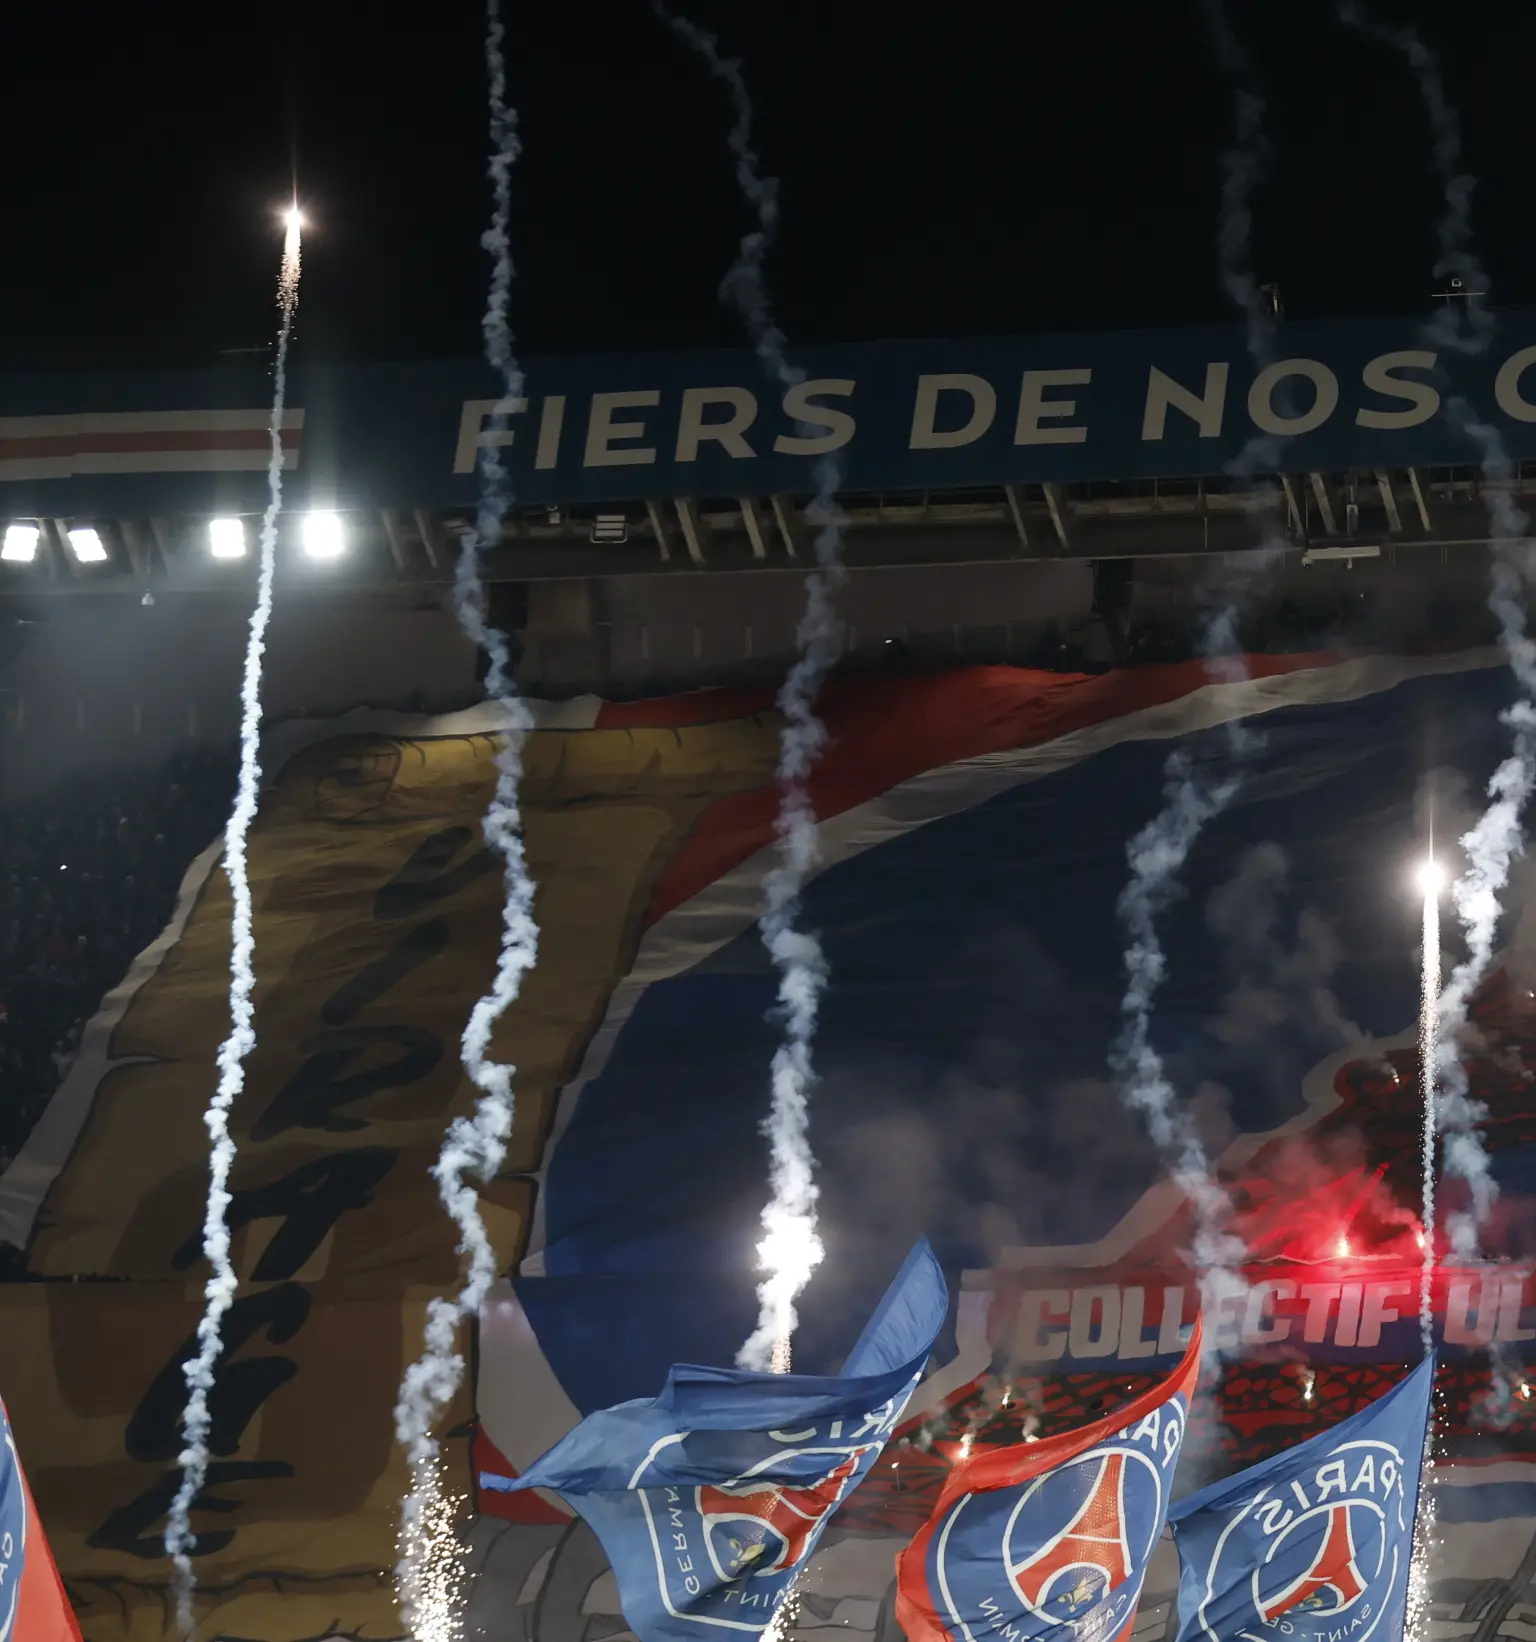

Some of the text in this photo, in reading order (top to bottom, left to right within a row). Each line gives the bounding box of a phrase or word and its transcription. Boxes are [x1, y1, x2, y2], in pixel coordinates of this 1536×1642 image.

[452, 378, 856, 474] FIERS
[908, 368, 1092, 450] DE
[1140, 349, 1441, 442] NOS
[1014, 1278, 1411, 1362] COLLECTIF
